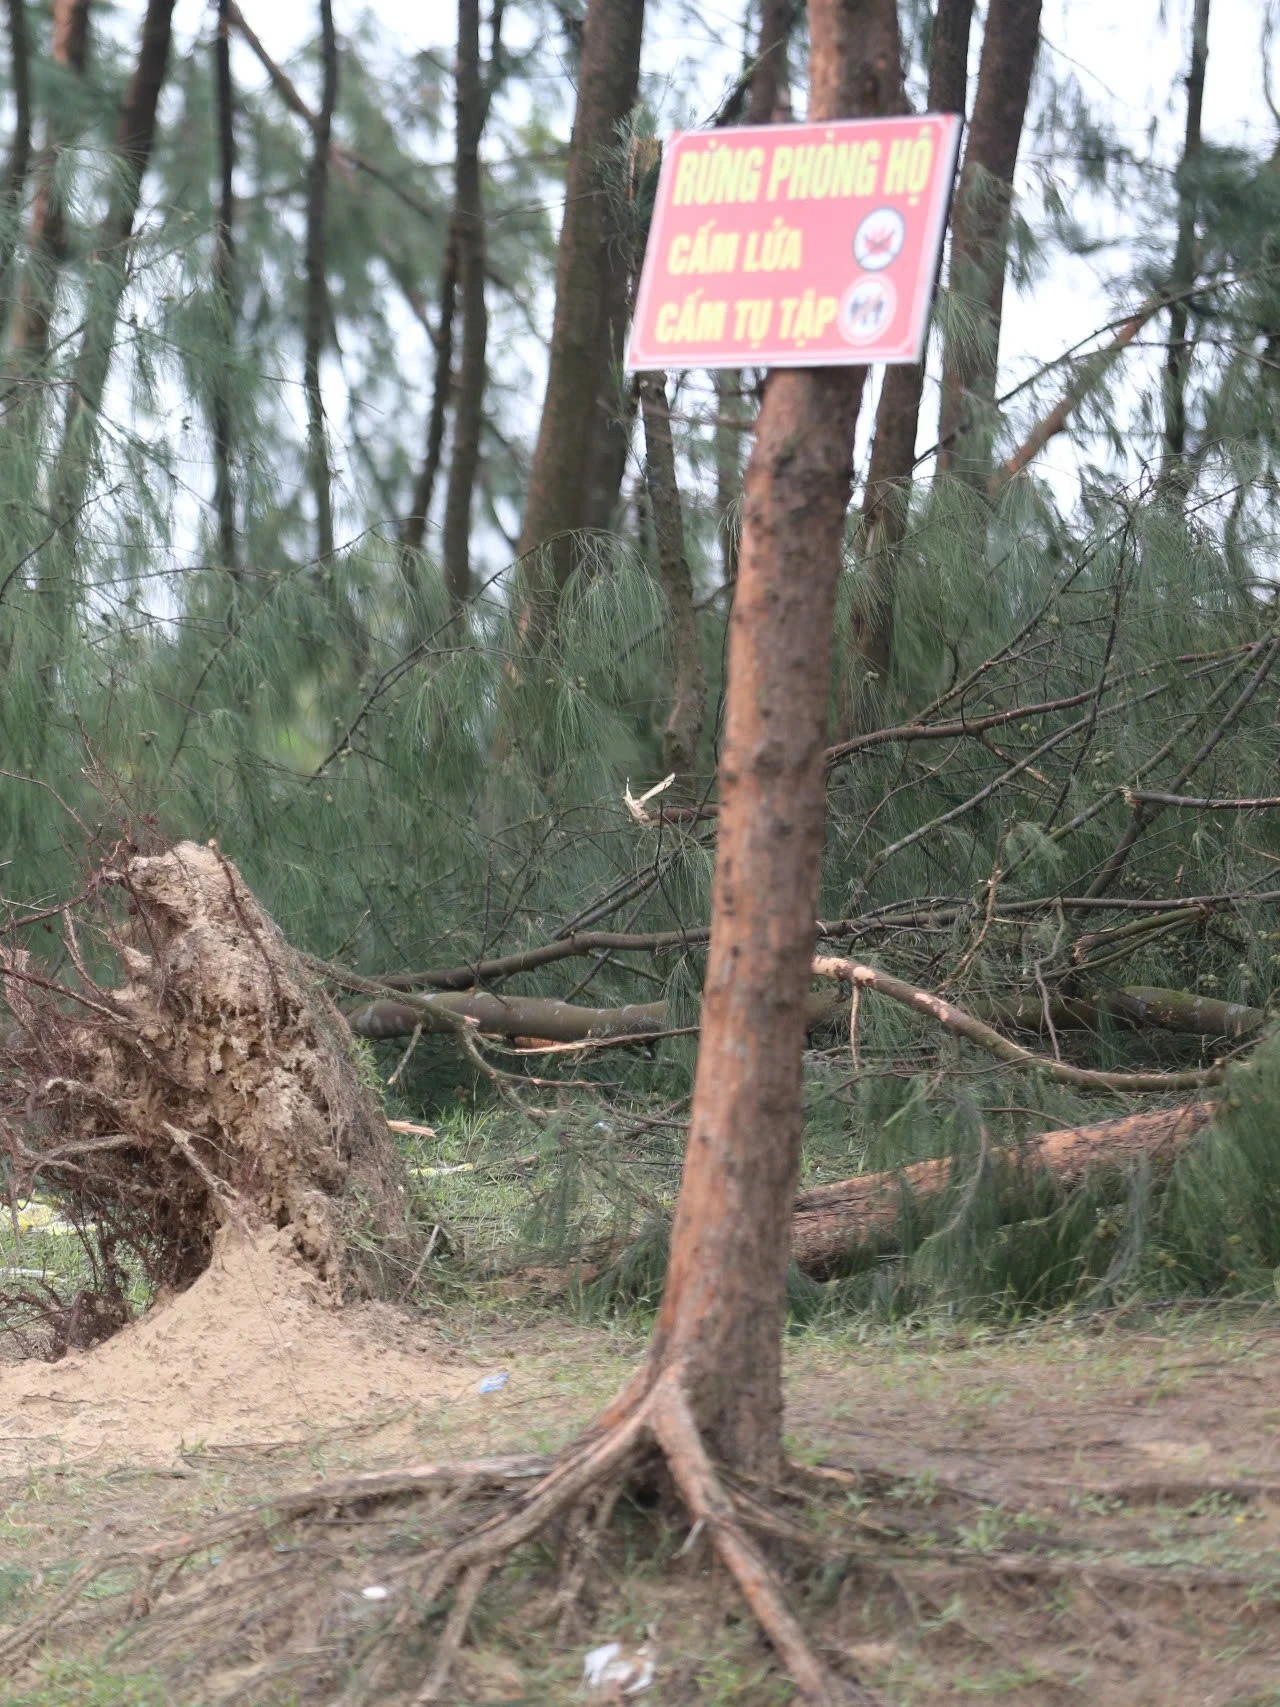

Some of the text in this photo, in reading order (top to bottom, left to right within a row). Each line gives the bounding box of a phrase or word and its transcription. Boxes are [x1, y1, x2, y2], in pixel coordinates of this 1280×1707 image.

[883, 125, 933, 207] HỘ
[668, 218, 740, 275] CẤM
[655, 287, 838, 349] CẤM TỤ TẬP
